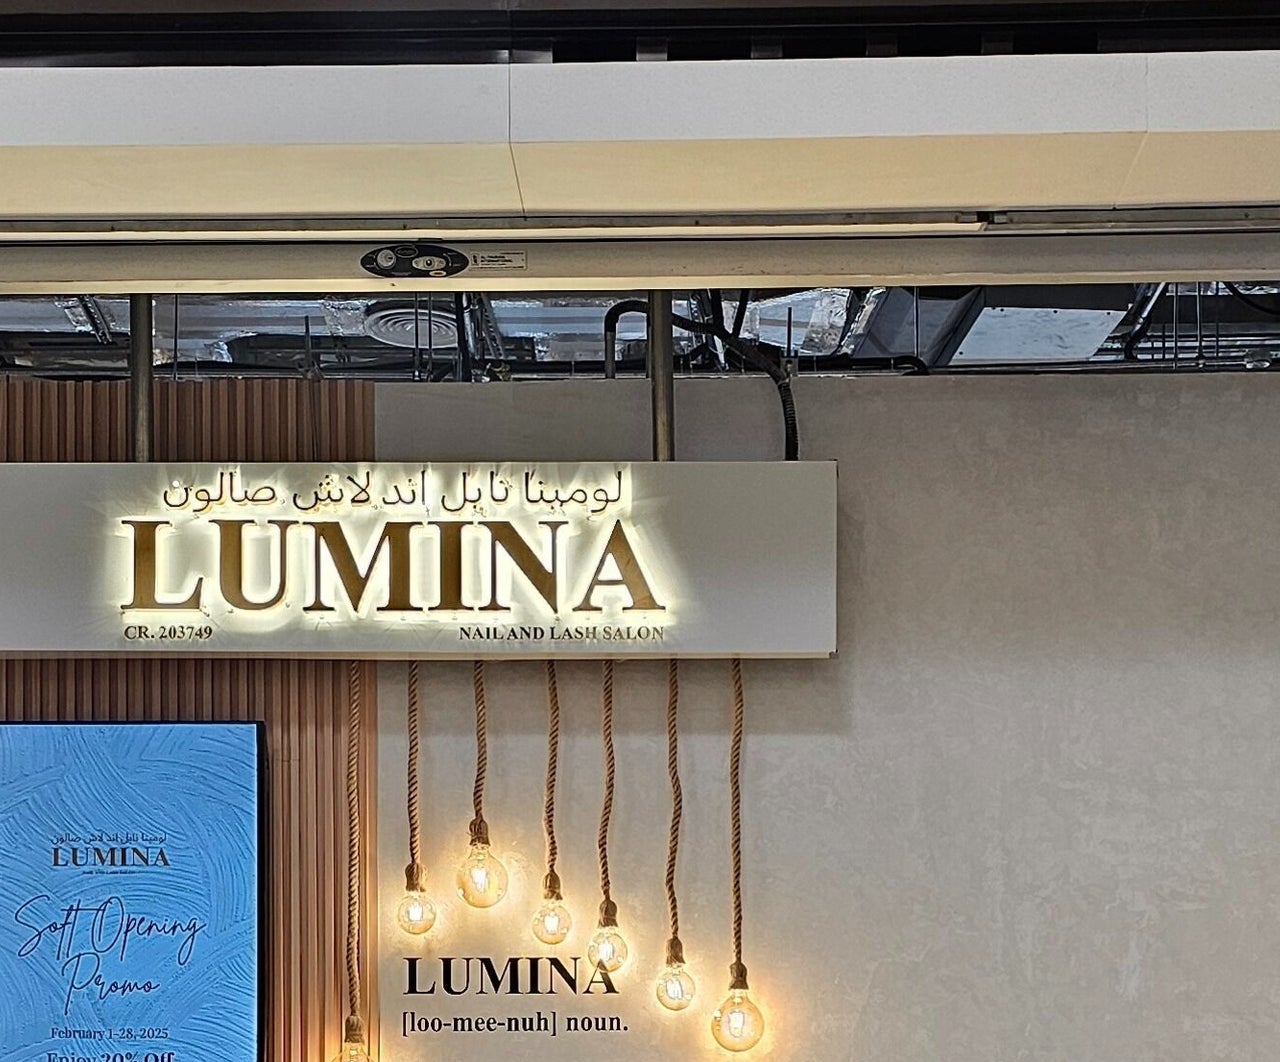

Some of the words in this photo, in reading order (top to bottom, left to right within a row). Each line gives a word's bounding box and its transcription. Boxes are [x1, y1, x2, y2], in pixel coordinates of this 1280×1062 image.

[163, 471, 276, 513] صالون
[292, 470, 371, 511] لاش
[524, 470, 622, 514] لومينا
[120, 519, 666, 613] LUMINA
[124, 625, 155, 640] CR.
[159, 625, 213, 640] 203749
[459, 625, 504, 641] NAIL
[507, 625, 545, 641] AND
[549, 625, 597, 641] LASH
[602, 625, 664, 641] SALON
[52, 847, 170, 867] LUMINA
[14, 894, 104, 960] Soft
[91, 896, 207, 966] Opening
[61, 951, 160, 1015] Promo
[403, 957, 619, 995] LUMINA
[50, 1027, 105, 1042] February
[139, 1027, 169, 1040] 2025
[402, 1011, 557, 1037] [loo-mee-nuh]
[566, 1013, 629, 1032] noun.
